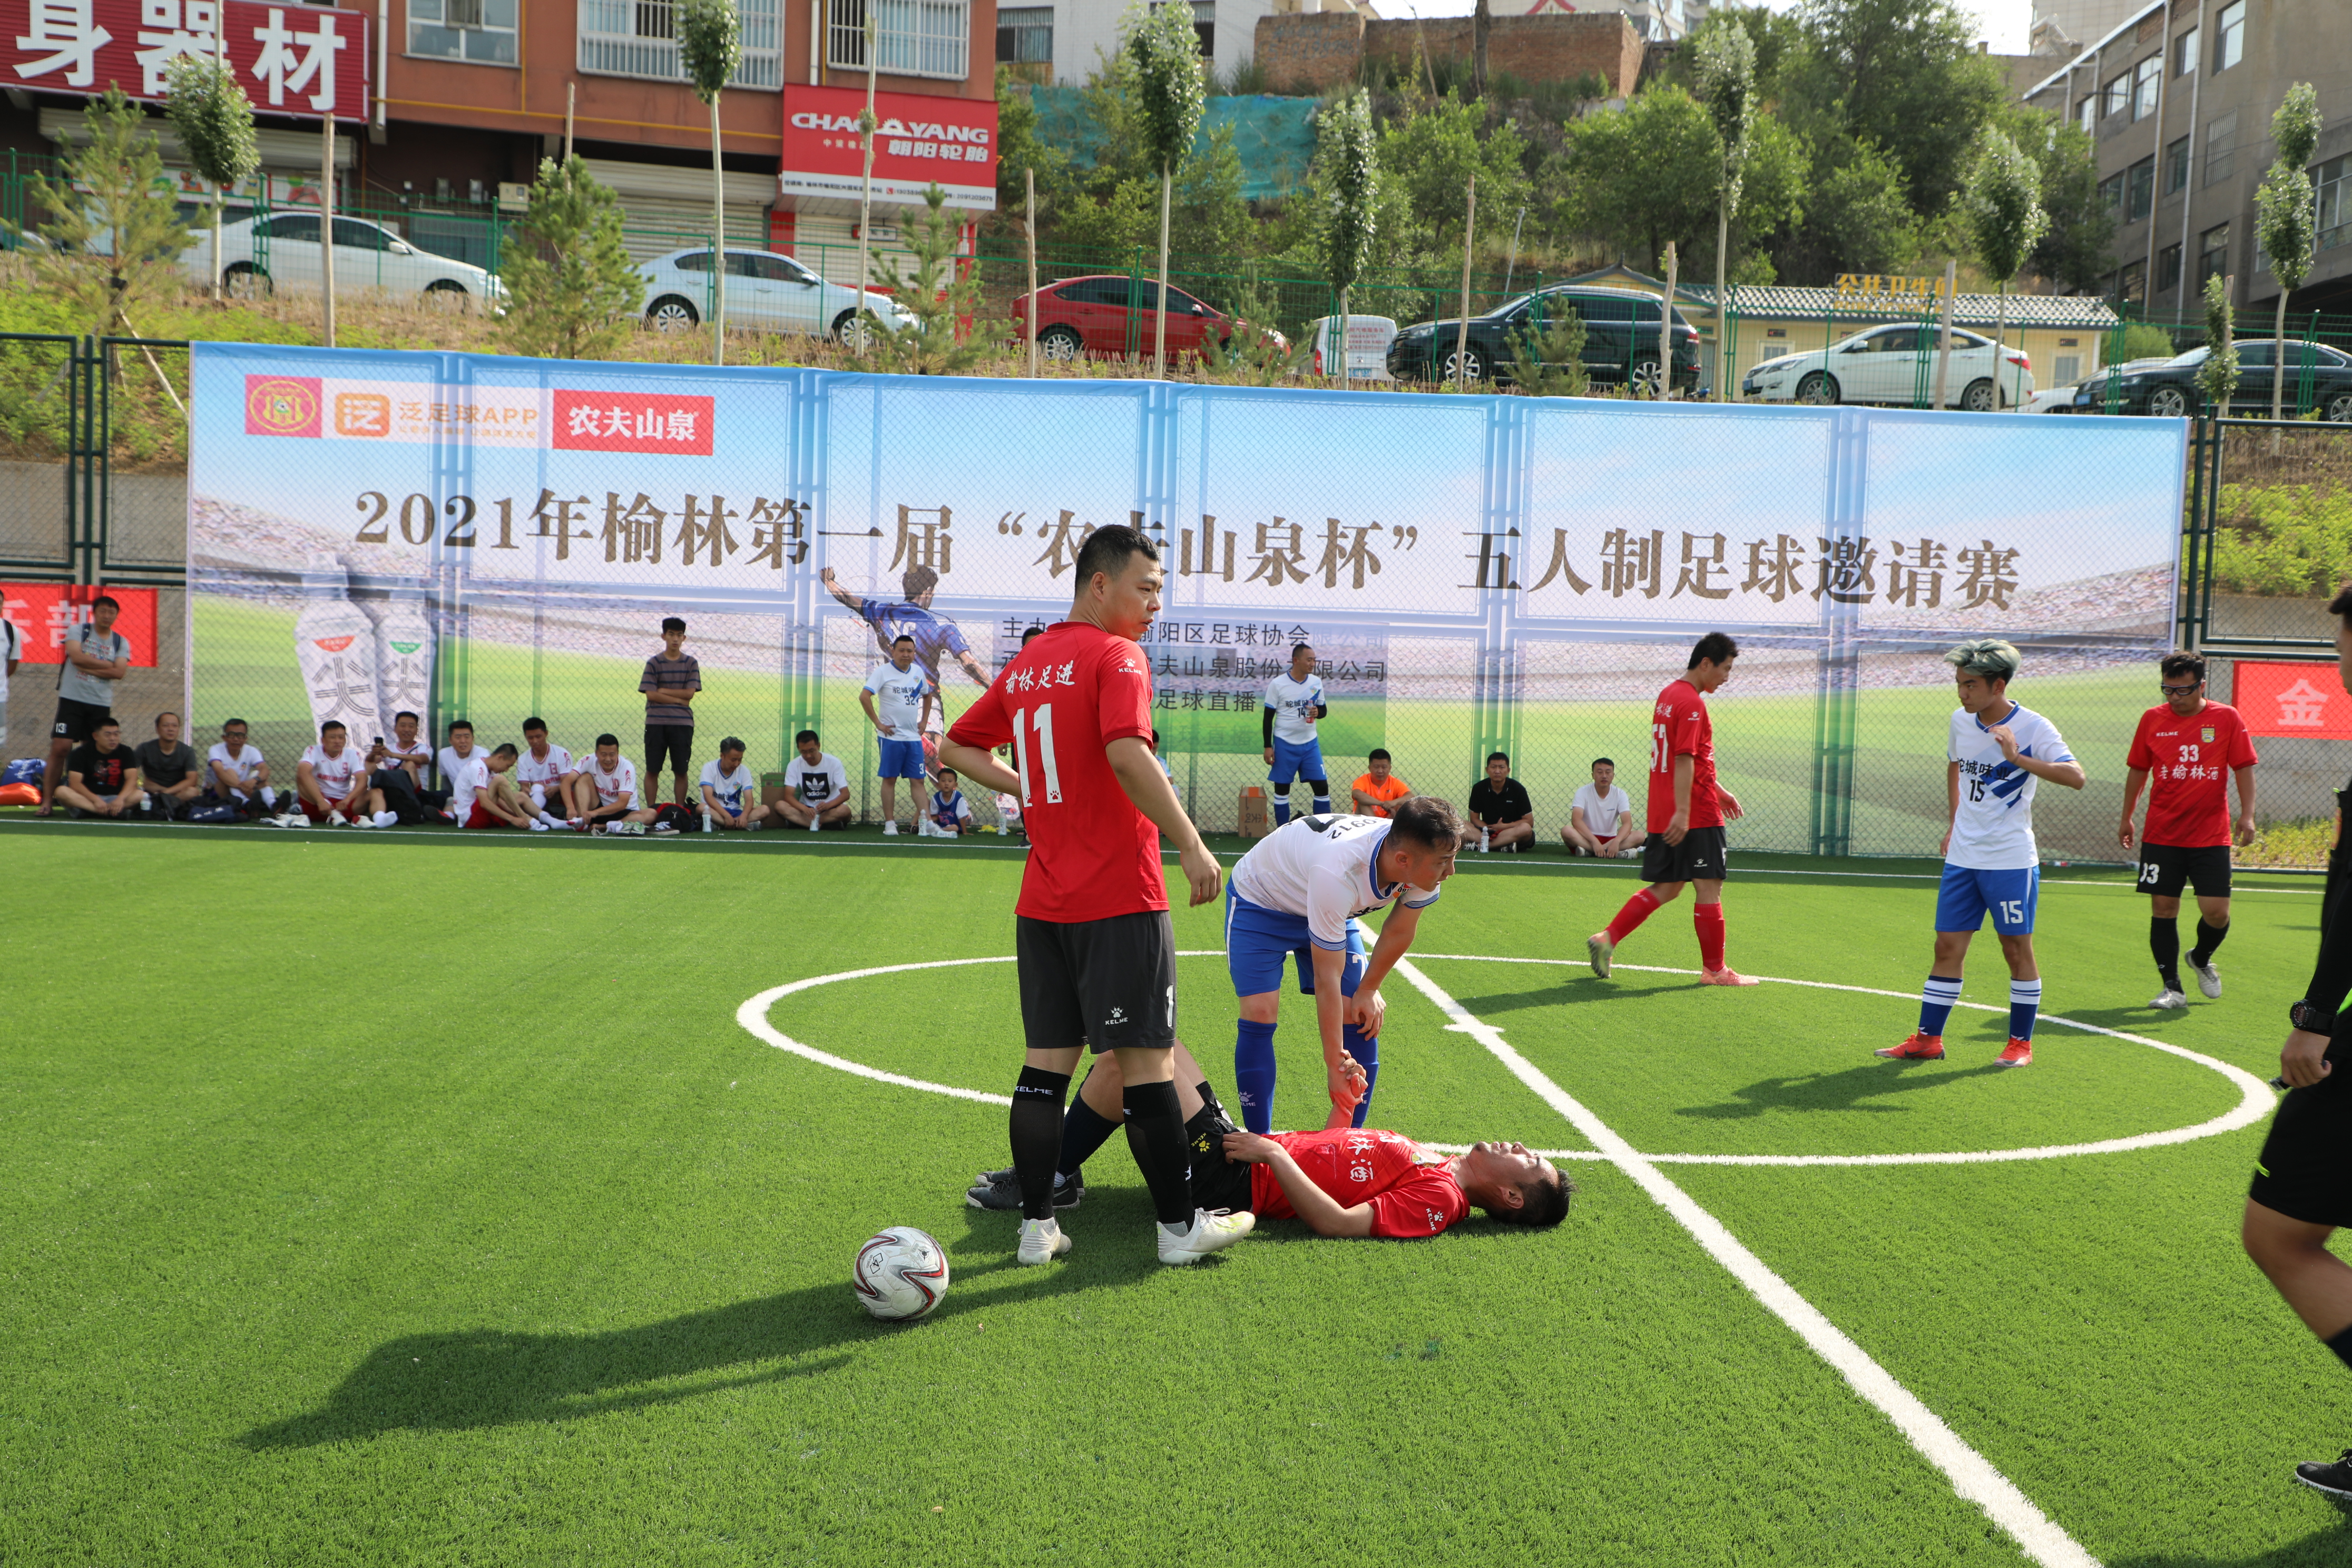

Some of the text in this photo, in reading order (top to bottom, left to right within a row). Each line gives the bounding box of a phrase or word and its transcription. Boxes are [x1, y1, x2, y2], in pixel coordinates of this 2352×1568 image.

[908, 122, 988, 143] YANG
[888, 139, 988, 162] 朝阳轮胎
[399, 401, 538, 425] 泛足球APP
[567, 405, 697, 442] 农夫山泉
[1140, 655, 1385, 682] 夫山泉股份限公司
[904, 695, 915, 705] 32
[2275, 679, 2329, 727] 金
[1298, 708, 1306, 718] 14
[1013, 703, 1063, 808] 11
[2179, 744, 2200, 762] 33
[2159, 764, 2219, 780] 老榆林酒
[1969, 779, 1985, 802] 15
[2000, 900, 2024, 924] 15
[1191, 1132, 1207, 1147] KELME
[1426, 1208, 1436, 1231] KELME
